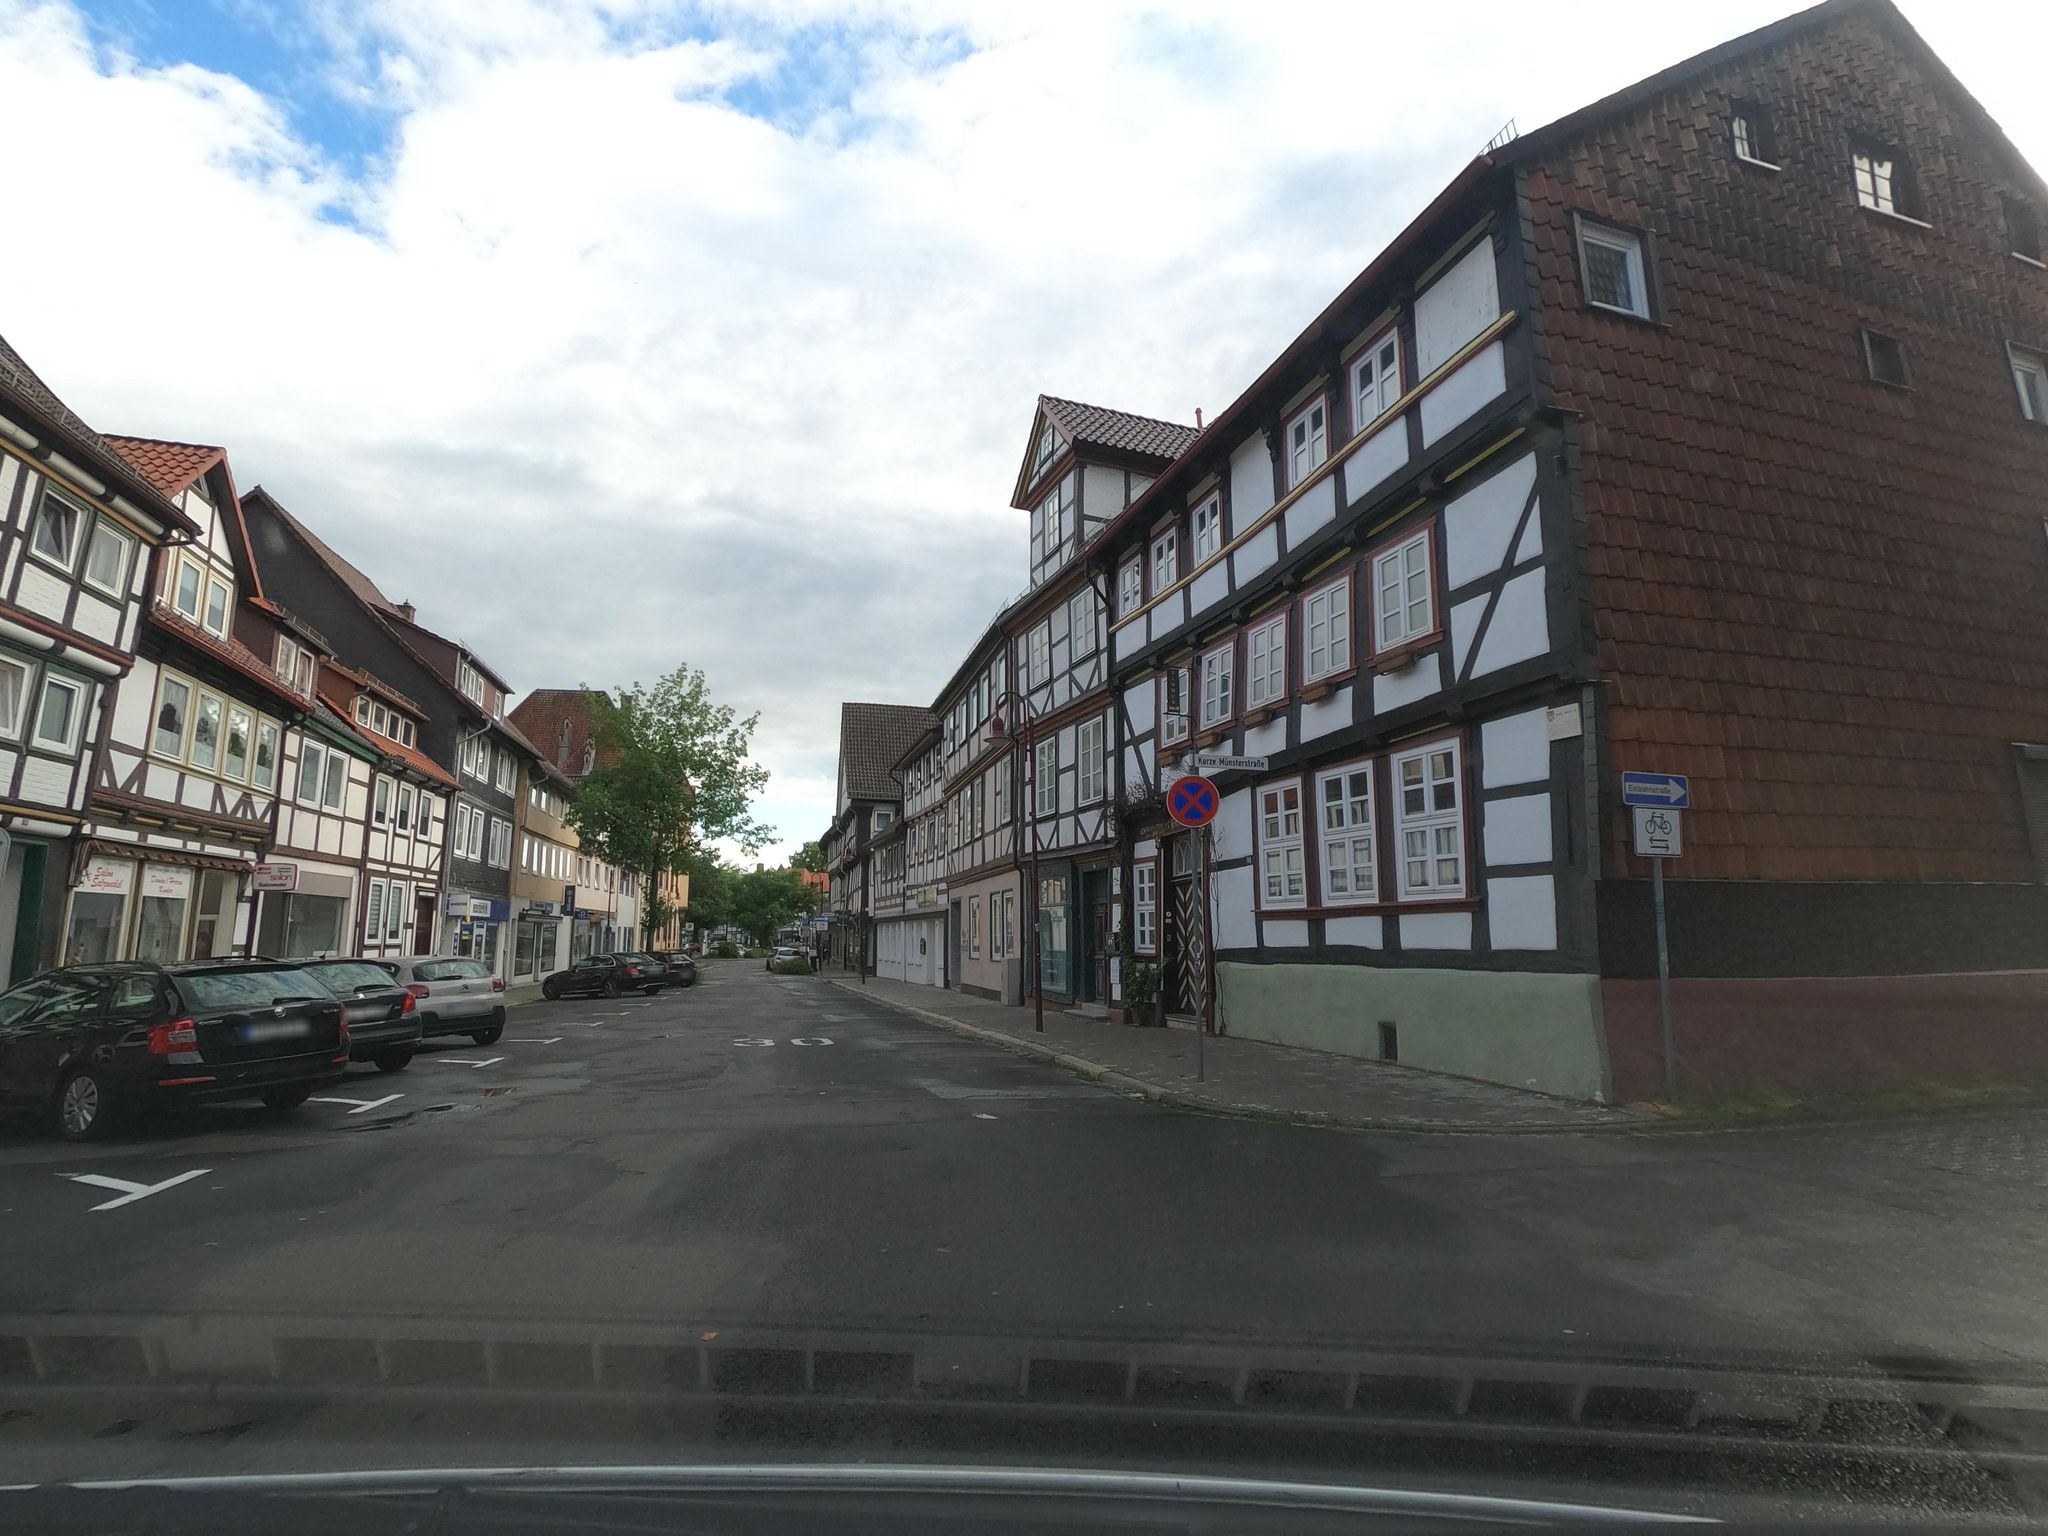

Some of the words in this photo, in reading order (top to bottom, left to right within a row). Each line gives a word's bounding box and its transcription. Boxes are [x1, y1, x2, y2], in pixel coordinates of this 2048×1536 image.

[1198, 756, 1216, 766] Kurze
[1219, 757, 1264, 768] Münsterstraße
[269, 873, 292, 881] salon
[733, 1037, 835, 1047] 30
